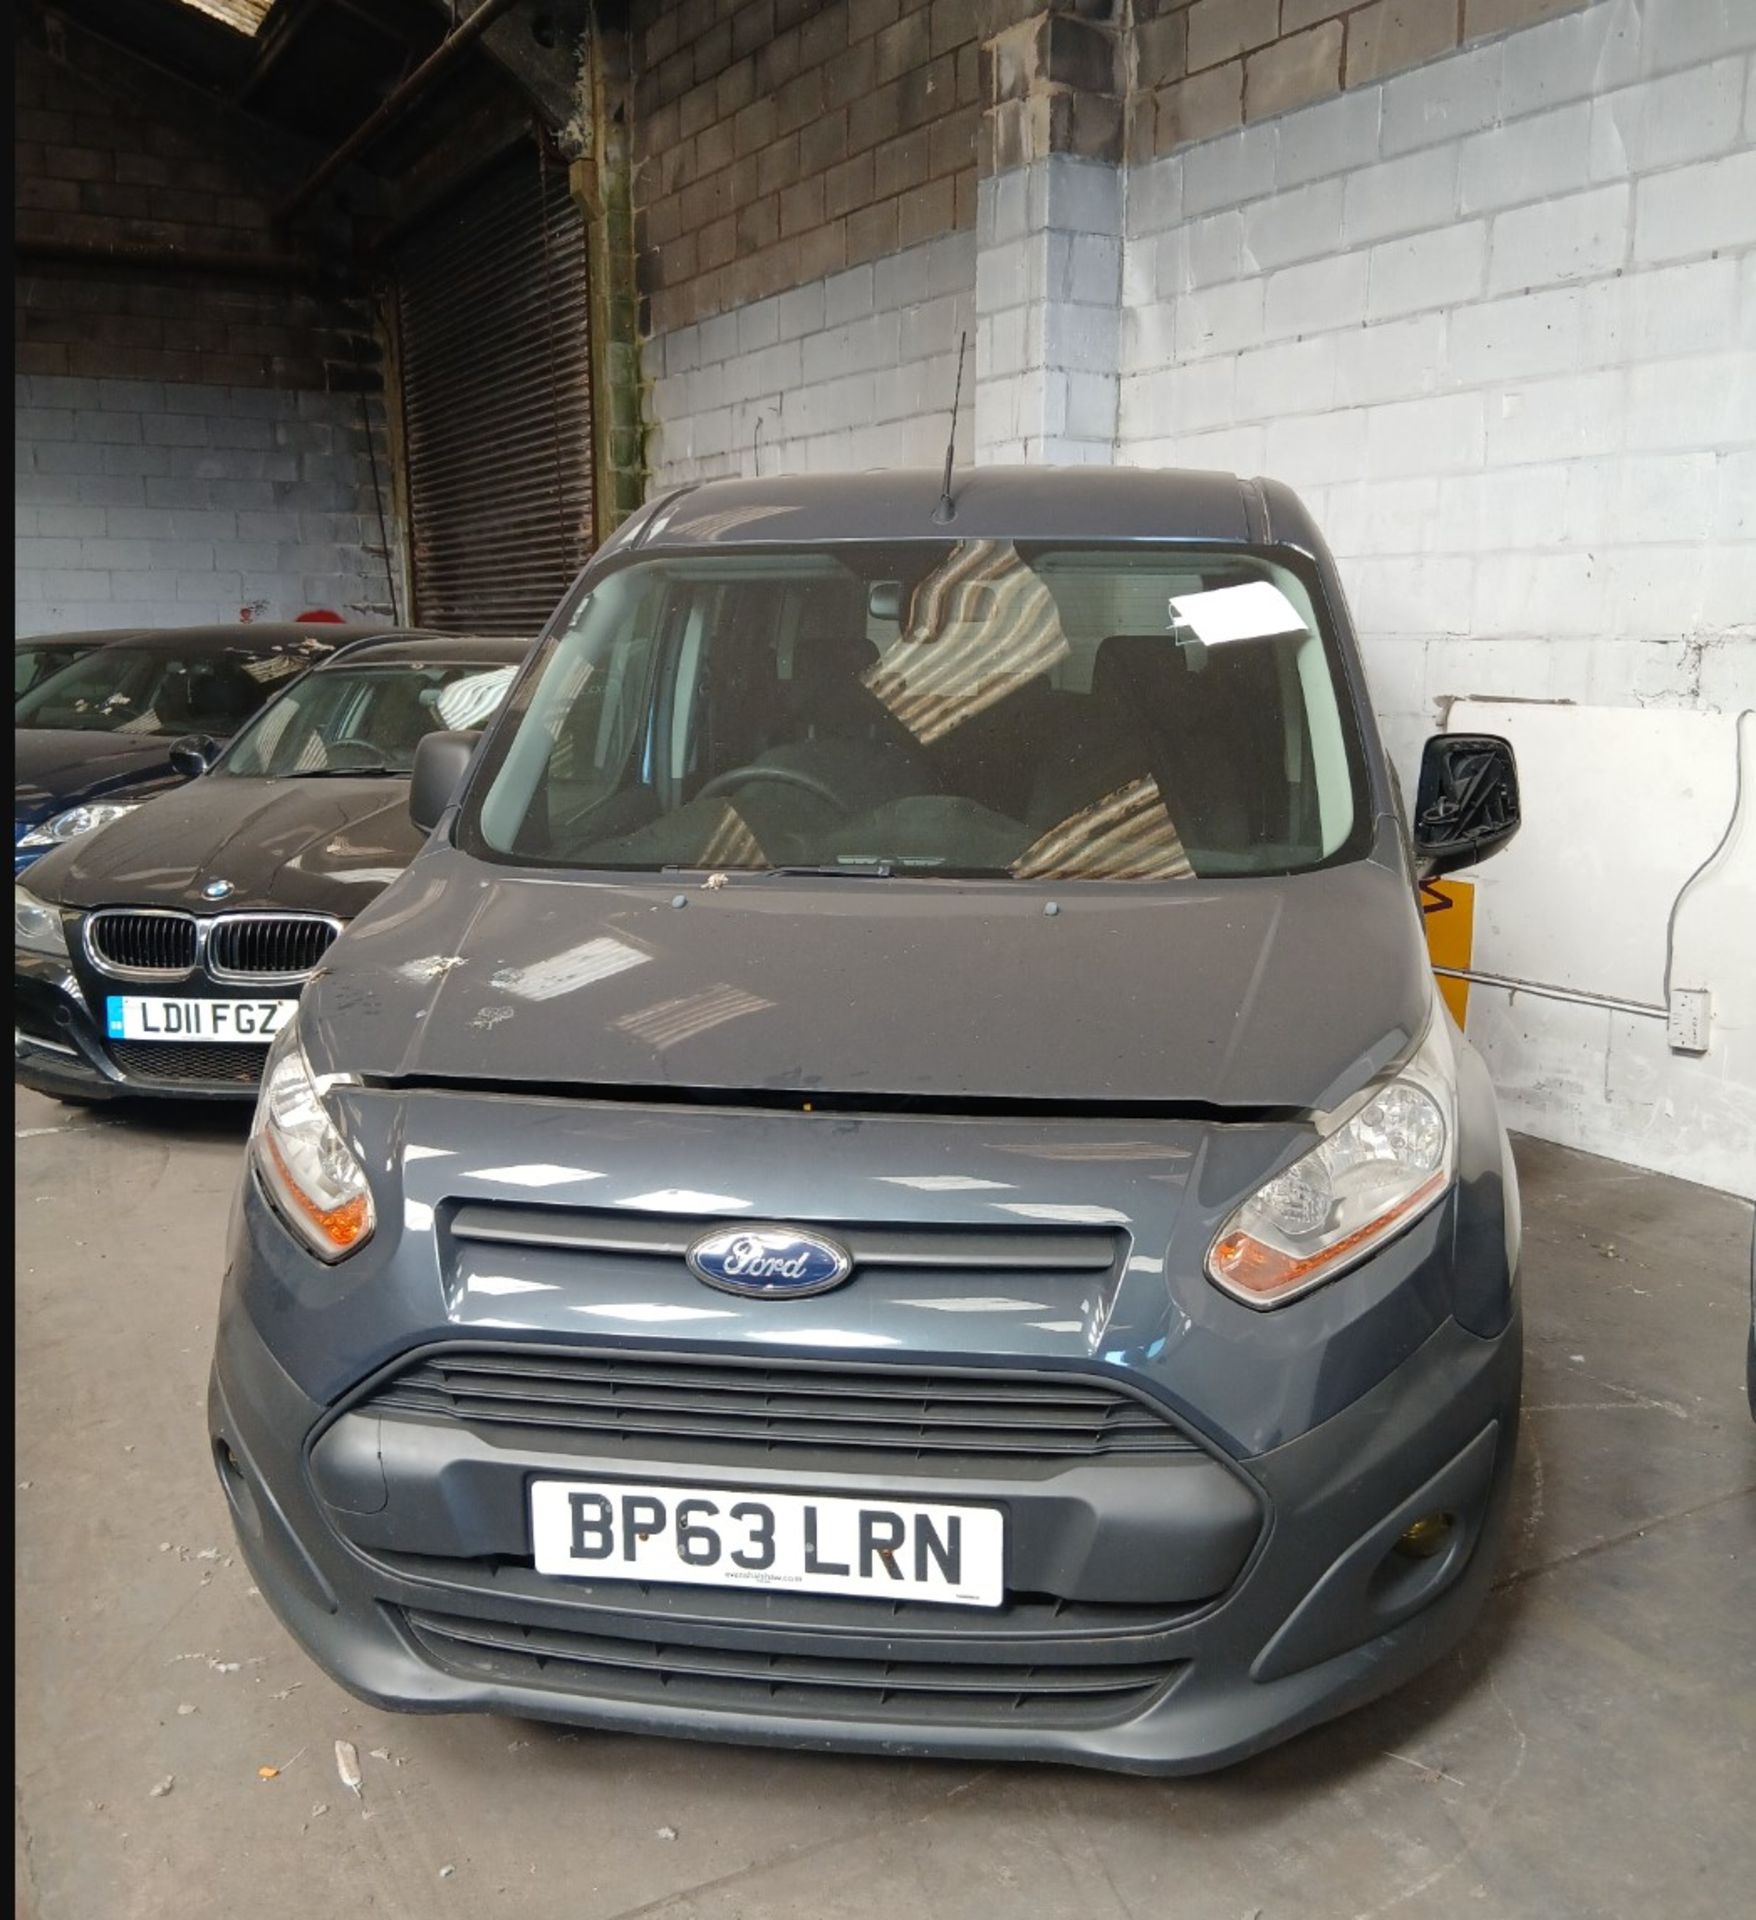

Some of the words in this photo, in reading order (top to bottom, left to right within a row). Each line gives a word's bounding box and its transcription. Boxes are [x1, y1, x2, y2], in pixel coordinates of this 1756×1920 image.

[142, 1002, 201, 1034] LD11
[211, 1003, 279, 1034] FGZ
[723, 1237, 810, 1278] Ford
[568, 1492, 775, 1571] BP63
[803, 1505, 962, 1585] LRN
